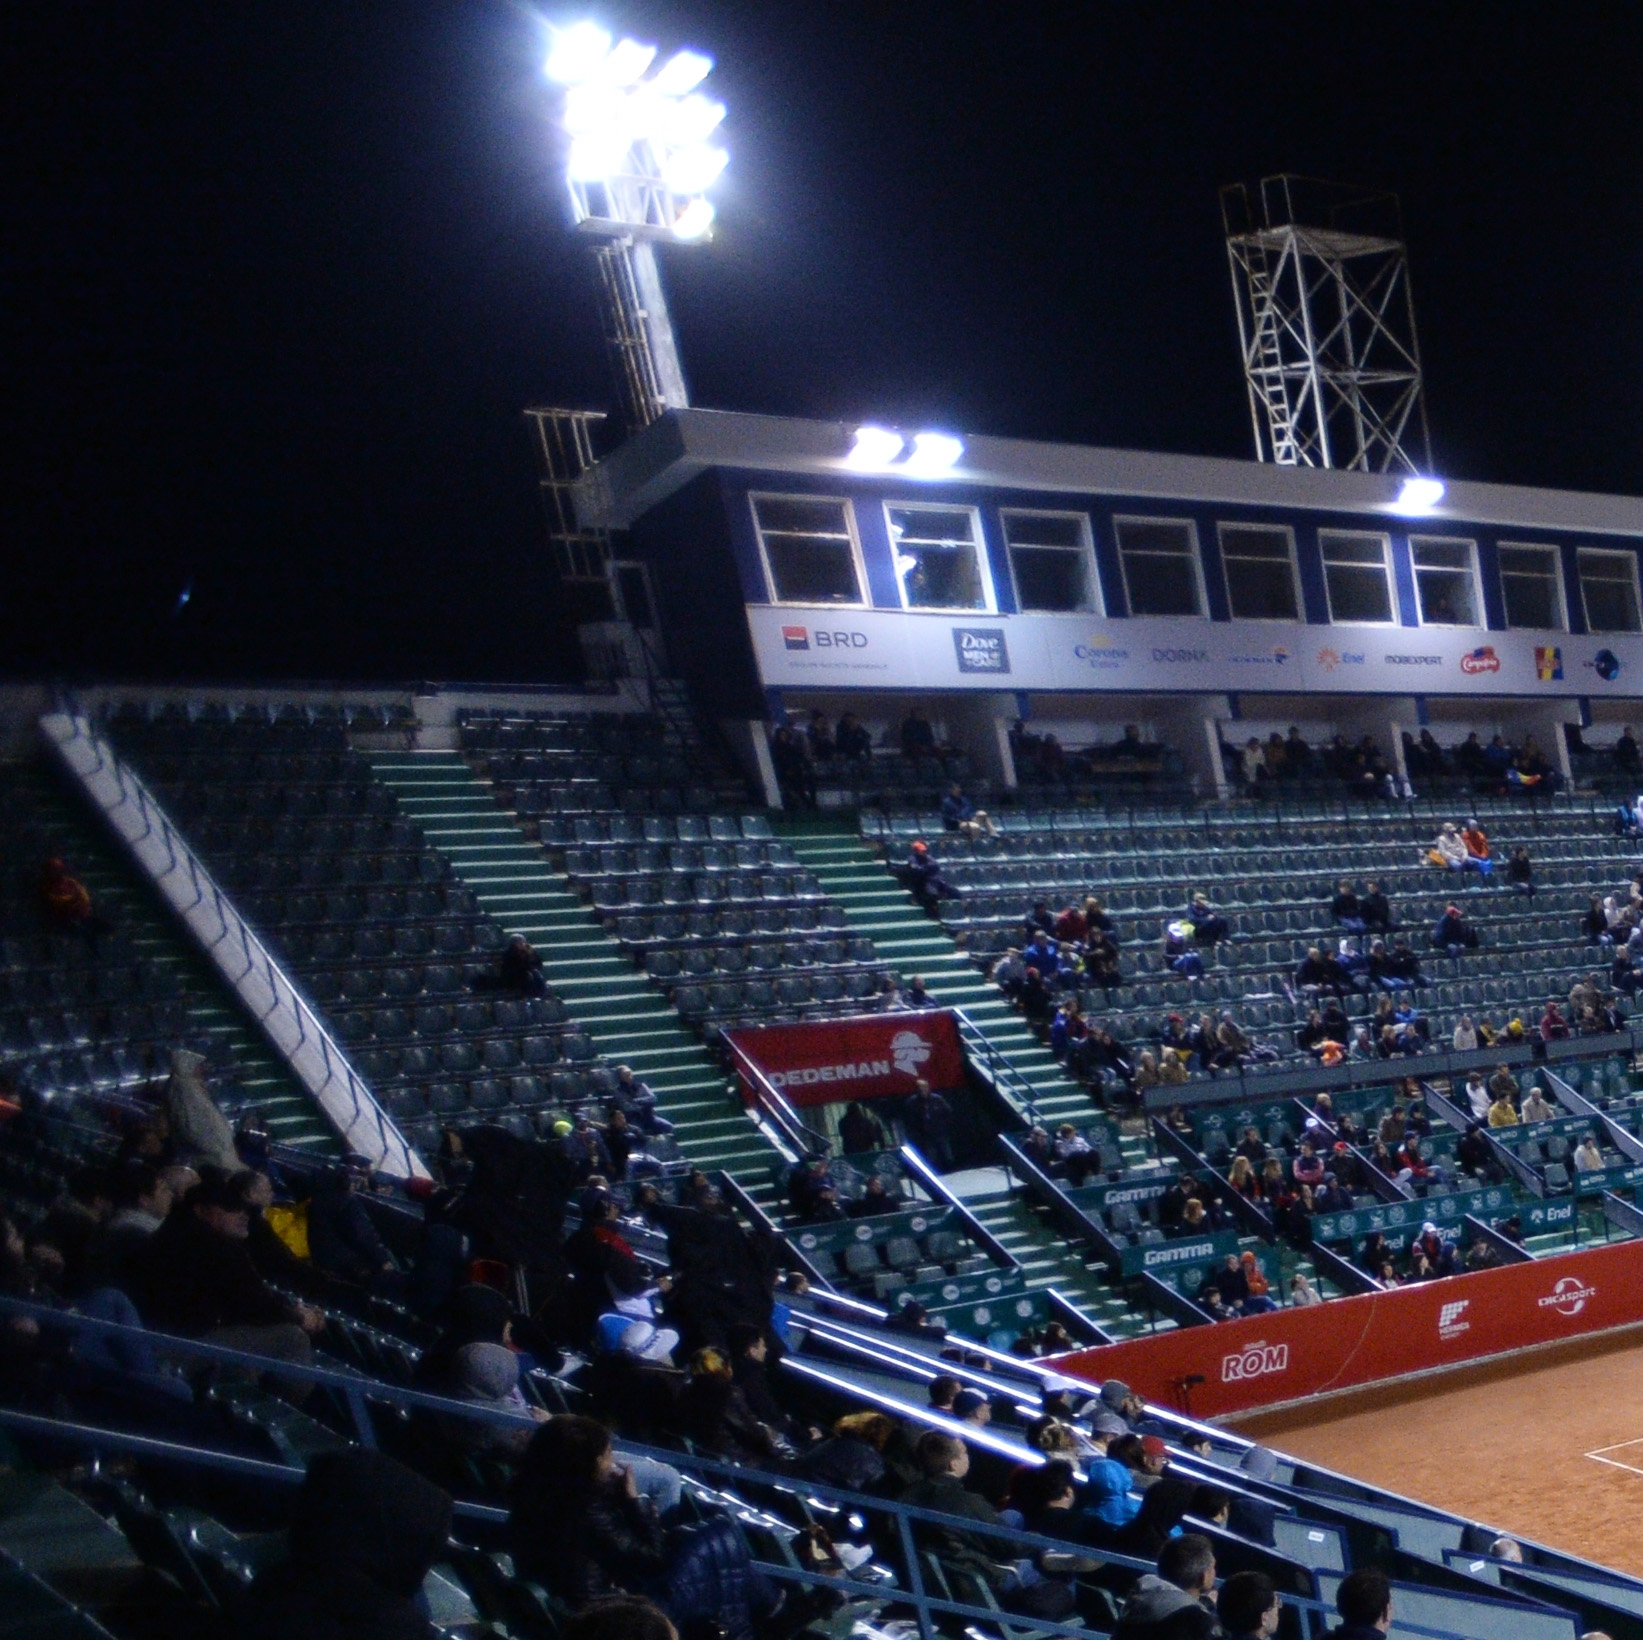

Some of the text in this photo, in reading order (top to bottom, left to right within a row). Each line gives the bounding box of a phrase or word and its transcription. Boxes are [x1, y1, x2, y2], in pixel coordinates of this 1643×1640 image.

[814, 630, 869, 649] BRD
[961, 632, 999, 650] Dove
[767, 1059, 890, 1088] DEDEMAN
[1104, 1184, 1167, 1204] GAMM
[1546, 1205, 1571, 1222] Enel
[1383, 1233, 1404, 1250] nel
[1436, 1226, 1462, 1244] Enel
[1143, 1242, 1214, 1266] GAMMA
[1221, 1343, 1288, 1383] ROM
